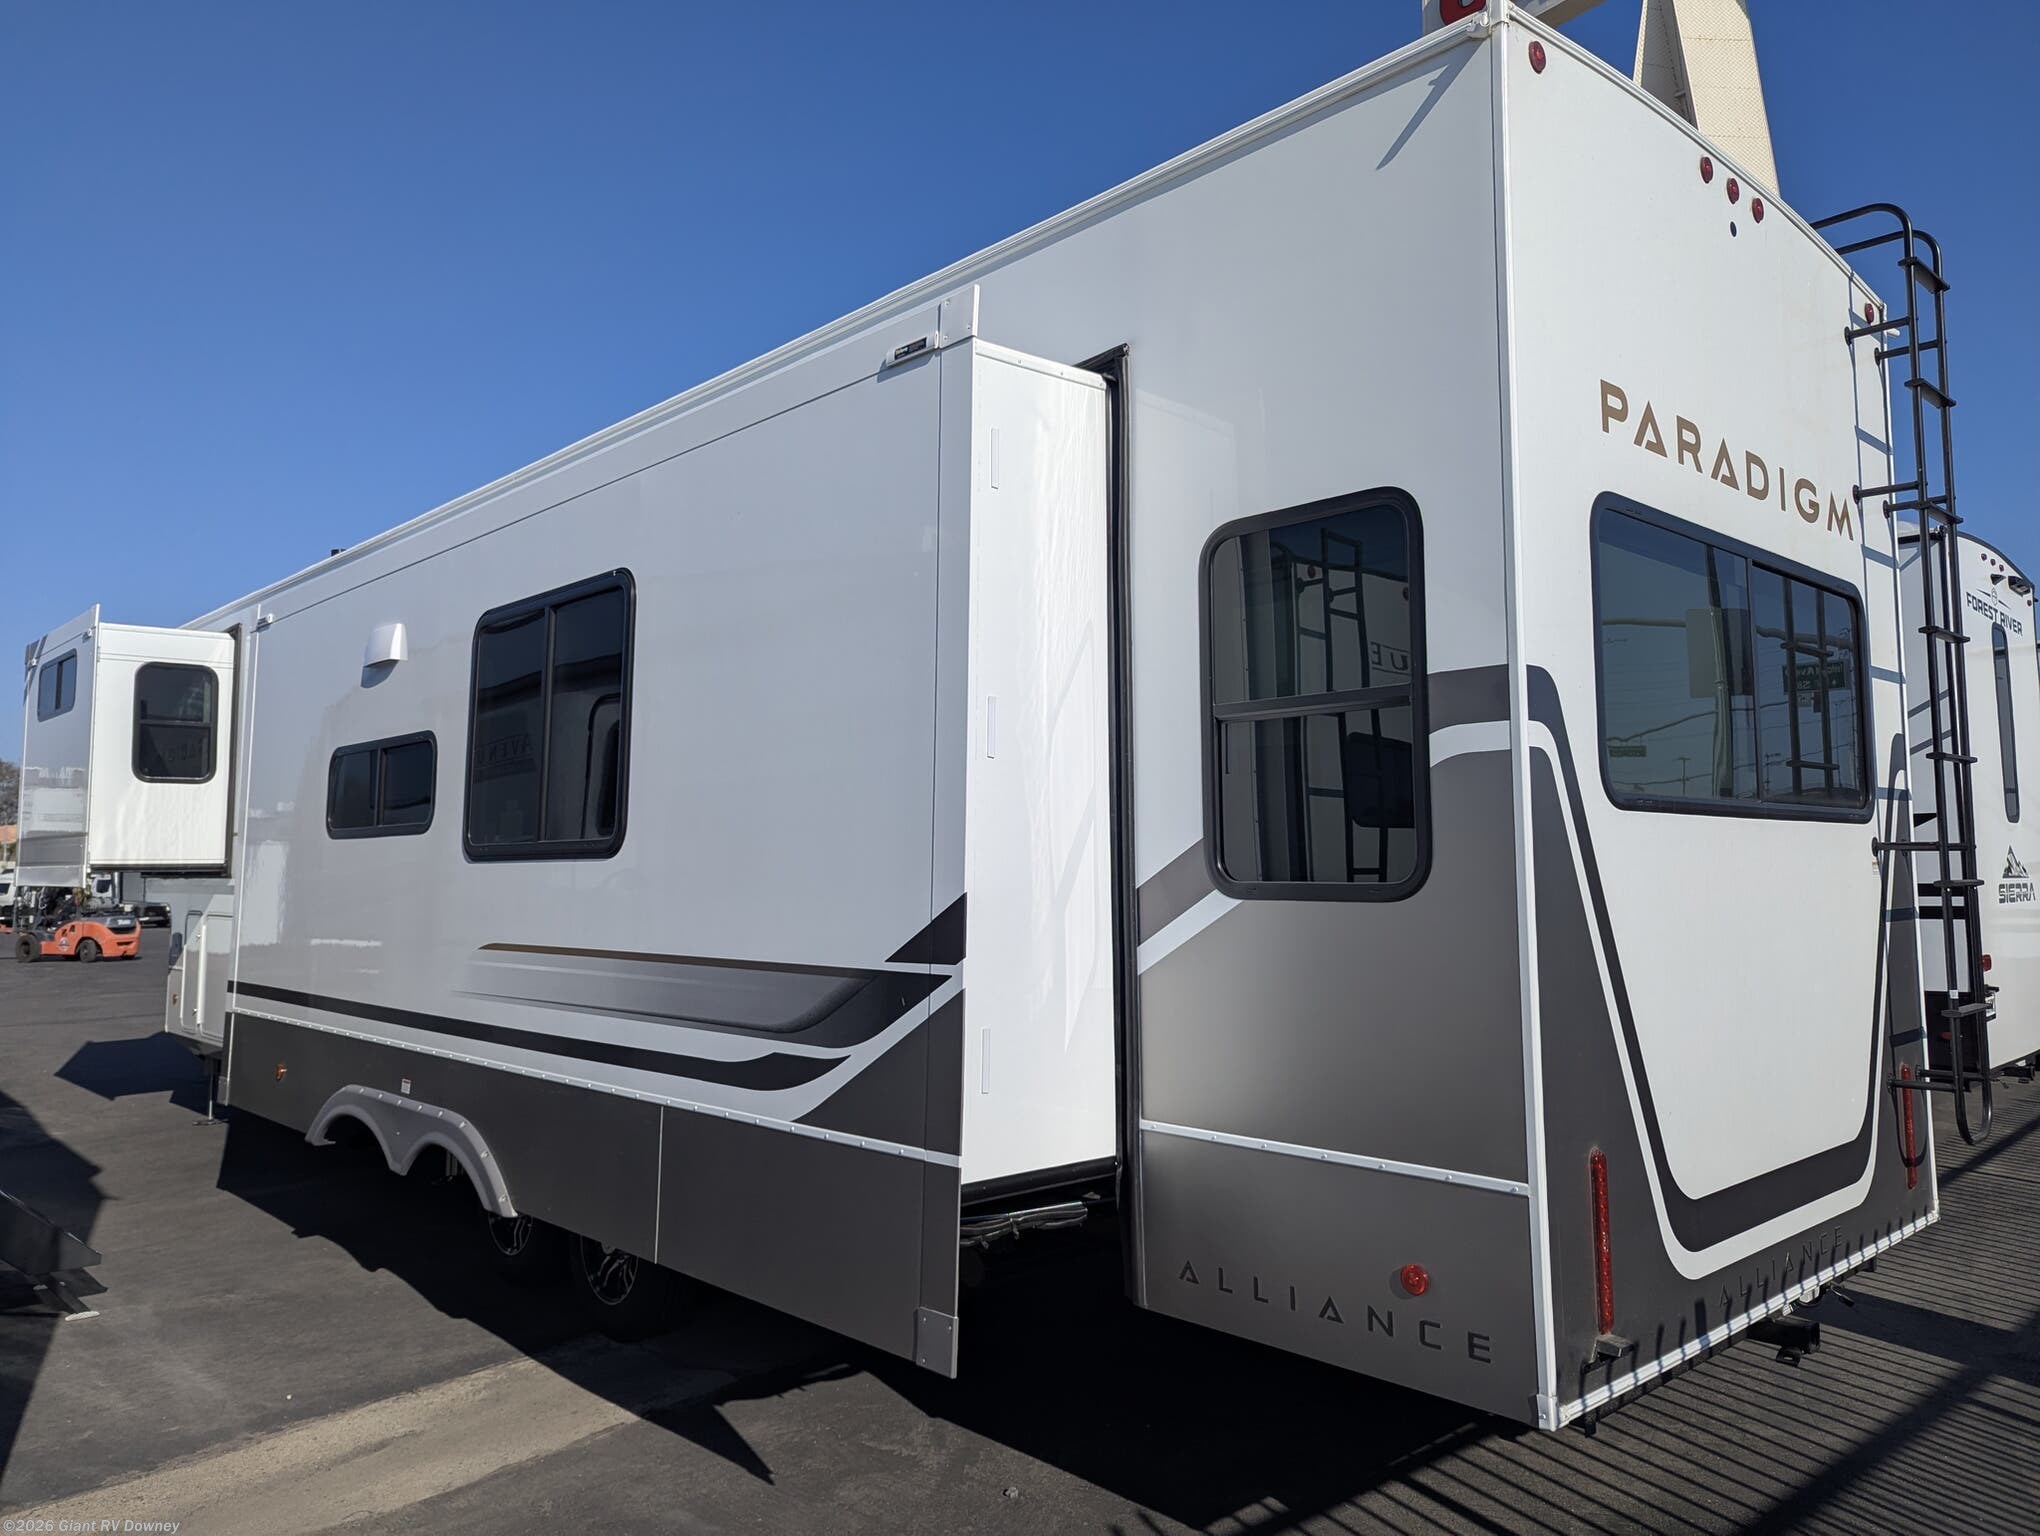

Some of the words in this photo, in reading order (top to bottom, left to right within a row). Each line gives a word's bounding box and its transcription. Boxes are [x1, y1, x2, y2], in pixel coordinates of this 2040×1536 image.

[1600, 379, 1853, 541] PARADIGM
[1966, 592, 1998, 621] FOREST
[2000, 611, 2023, 637] RIVER
[1999, 883, 2036, 903] SIERRA
[1720, 1226, 1843, 1307] ALLIANCE
[1178, 1260, 1492, 1364] ALLIANCE
